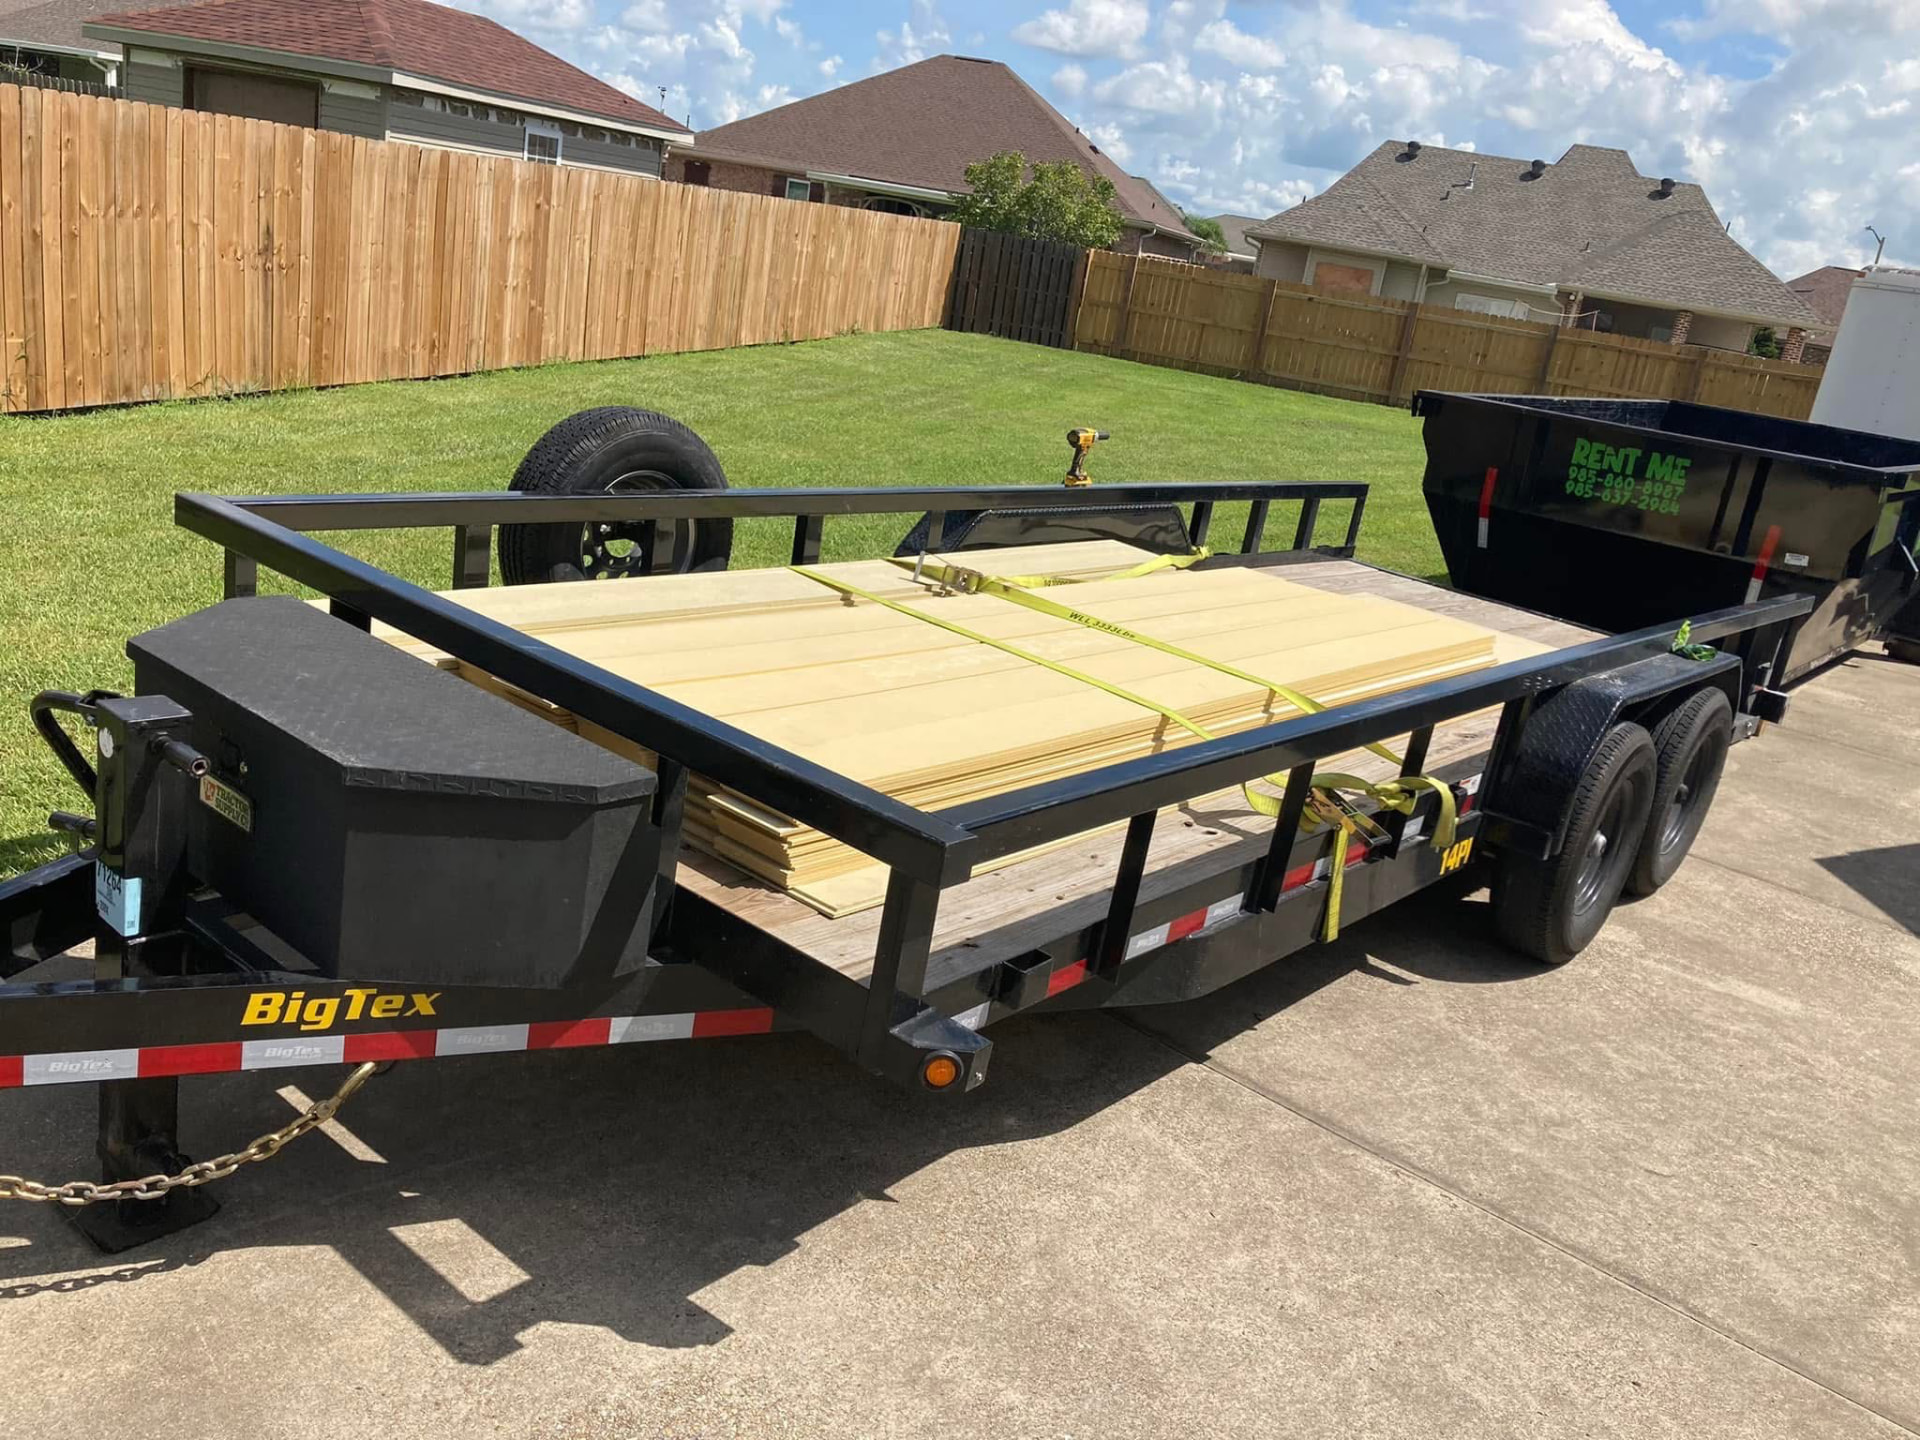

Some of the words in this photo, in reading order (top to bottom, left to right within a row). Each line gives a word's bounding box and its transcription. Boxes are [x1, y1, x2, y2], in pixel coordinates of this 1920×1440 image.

[1571, 437, 1642, 475] RENT
[1645, 452, 1692, 486] ME
[240, 988, 442, 1031] BigTex
[48, 1058, 113, 1074] BigTex
[264, 1045, 322, 1059] BigTex
